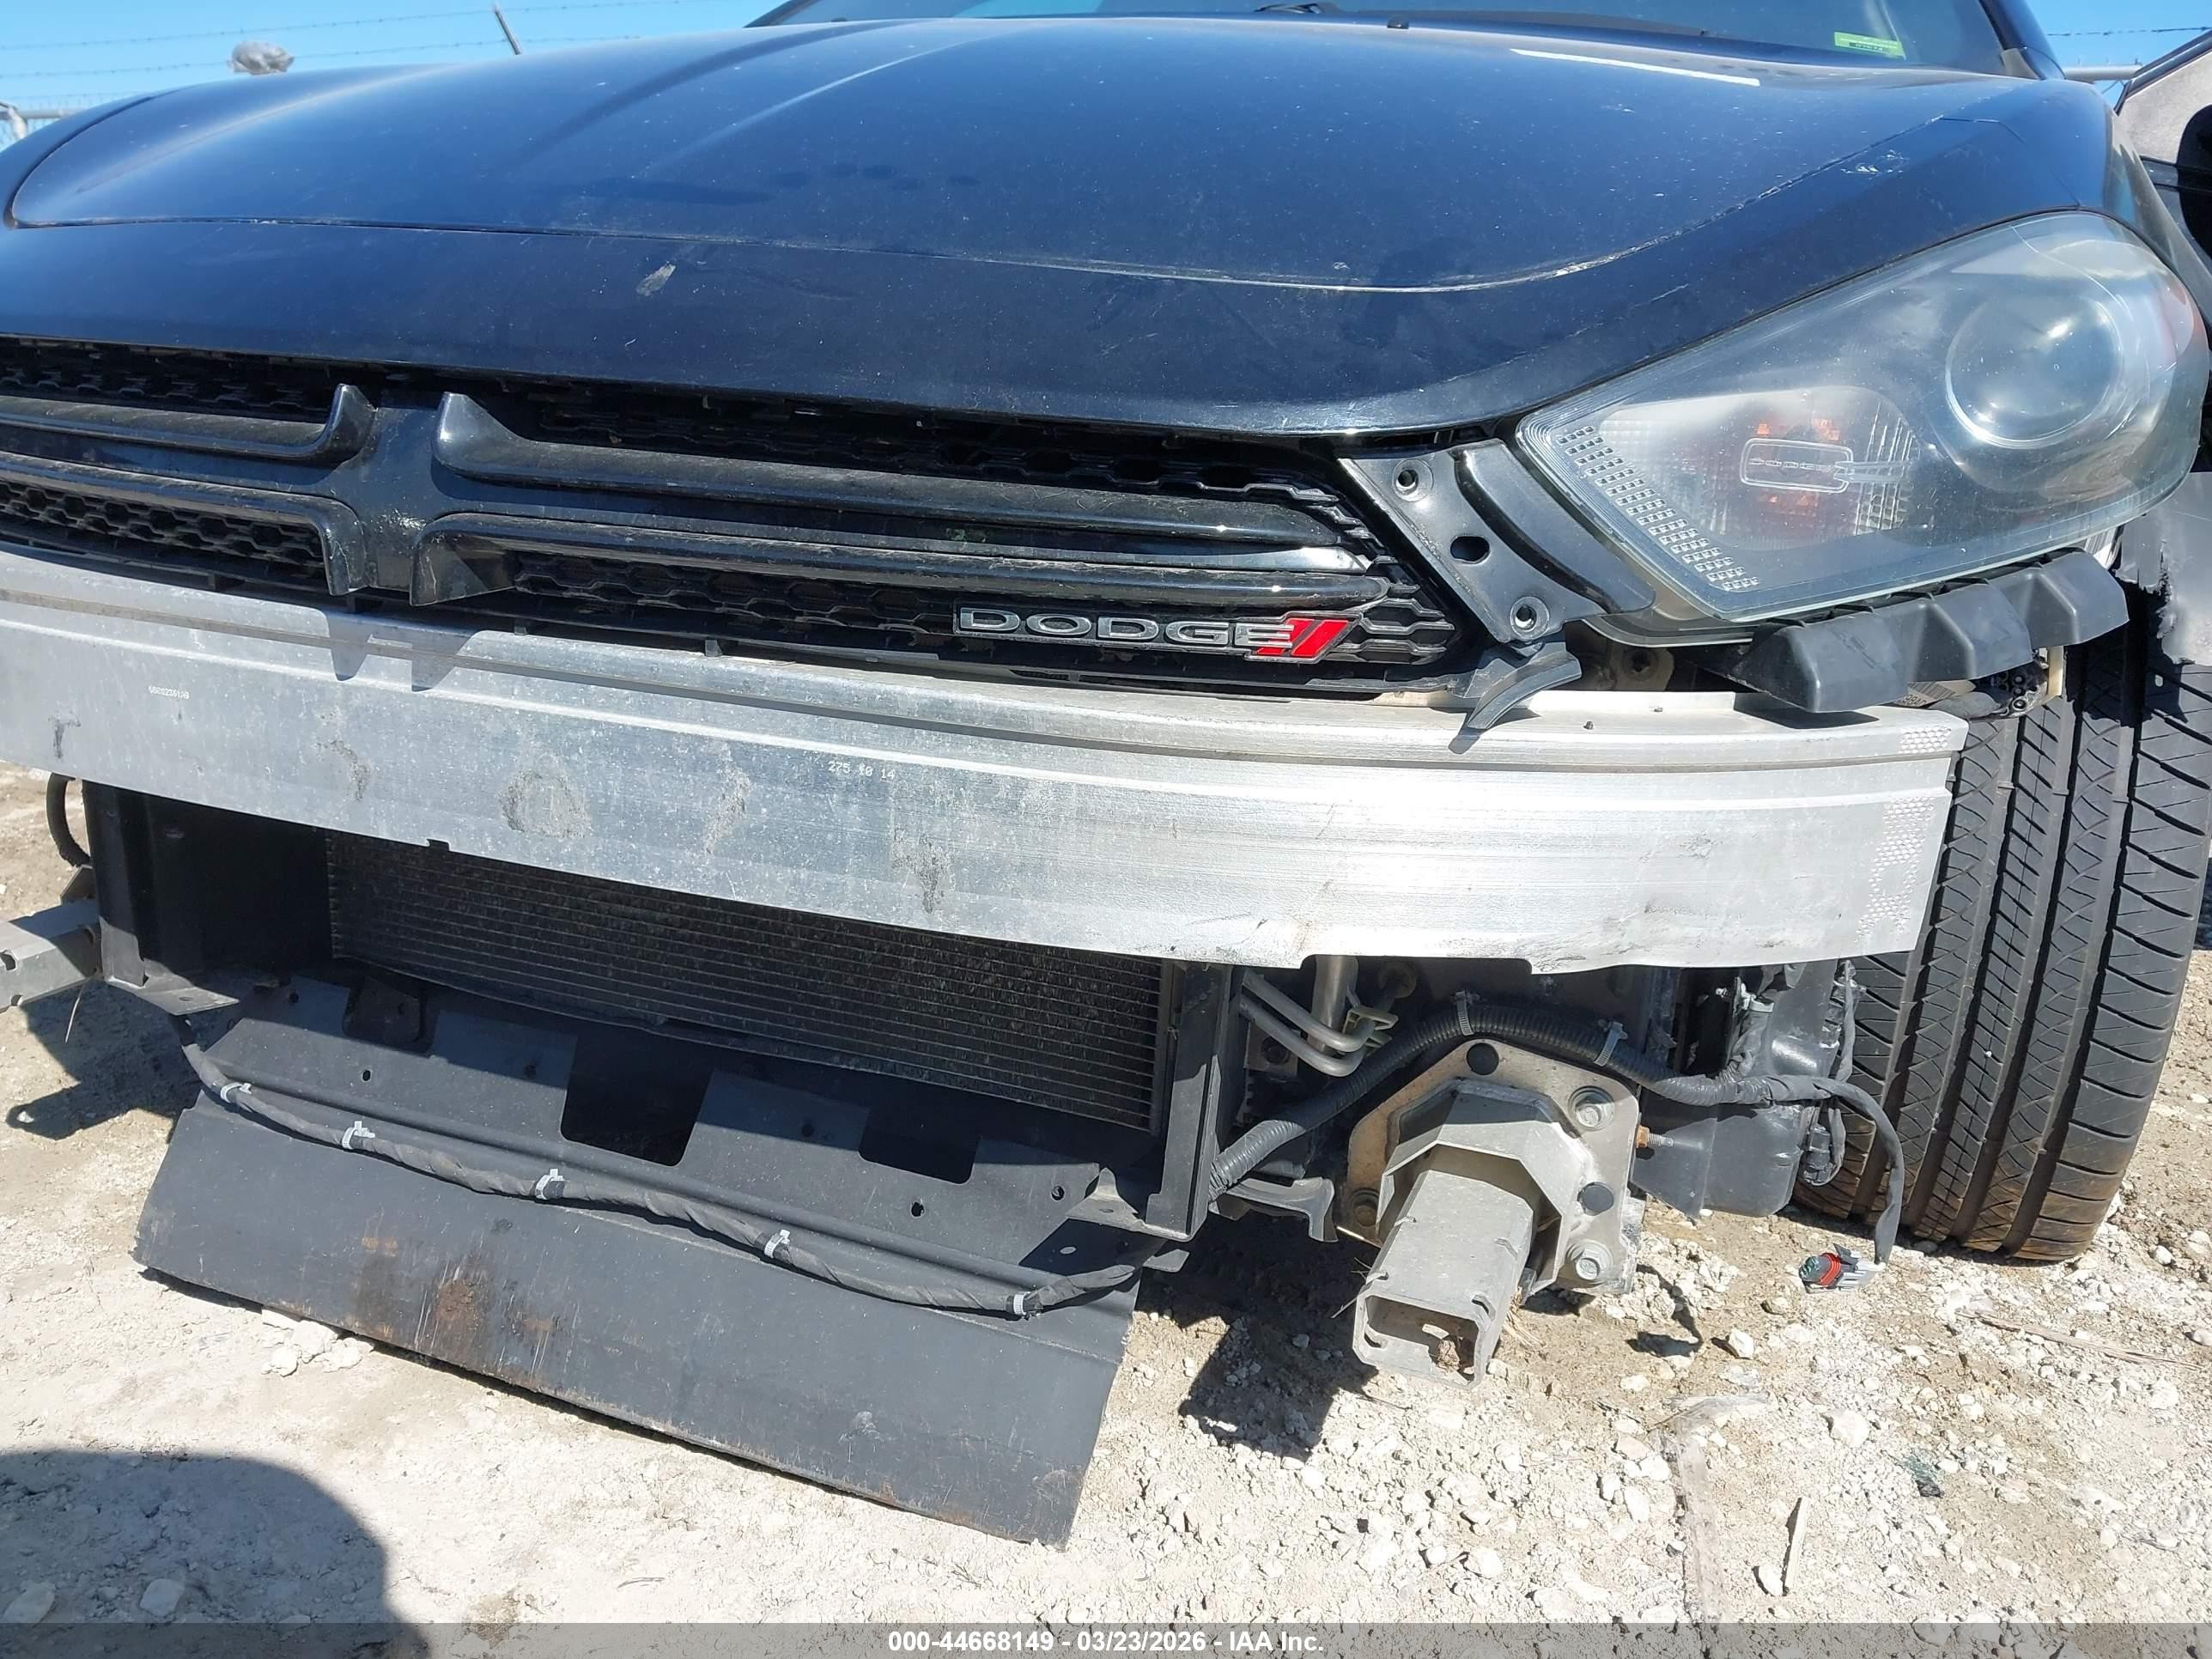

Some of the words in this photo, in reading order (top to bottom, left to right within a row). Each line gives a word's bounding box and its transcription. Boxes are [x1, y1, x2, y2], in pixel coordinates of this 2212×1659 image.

[960, 607, 1294, 648] DODGE
[828, 760, 851, 775] 275
[881, 768, 896, 780] 14
